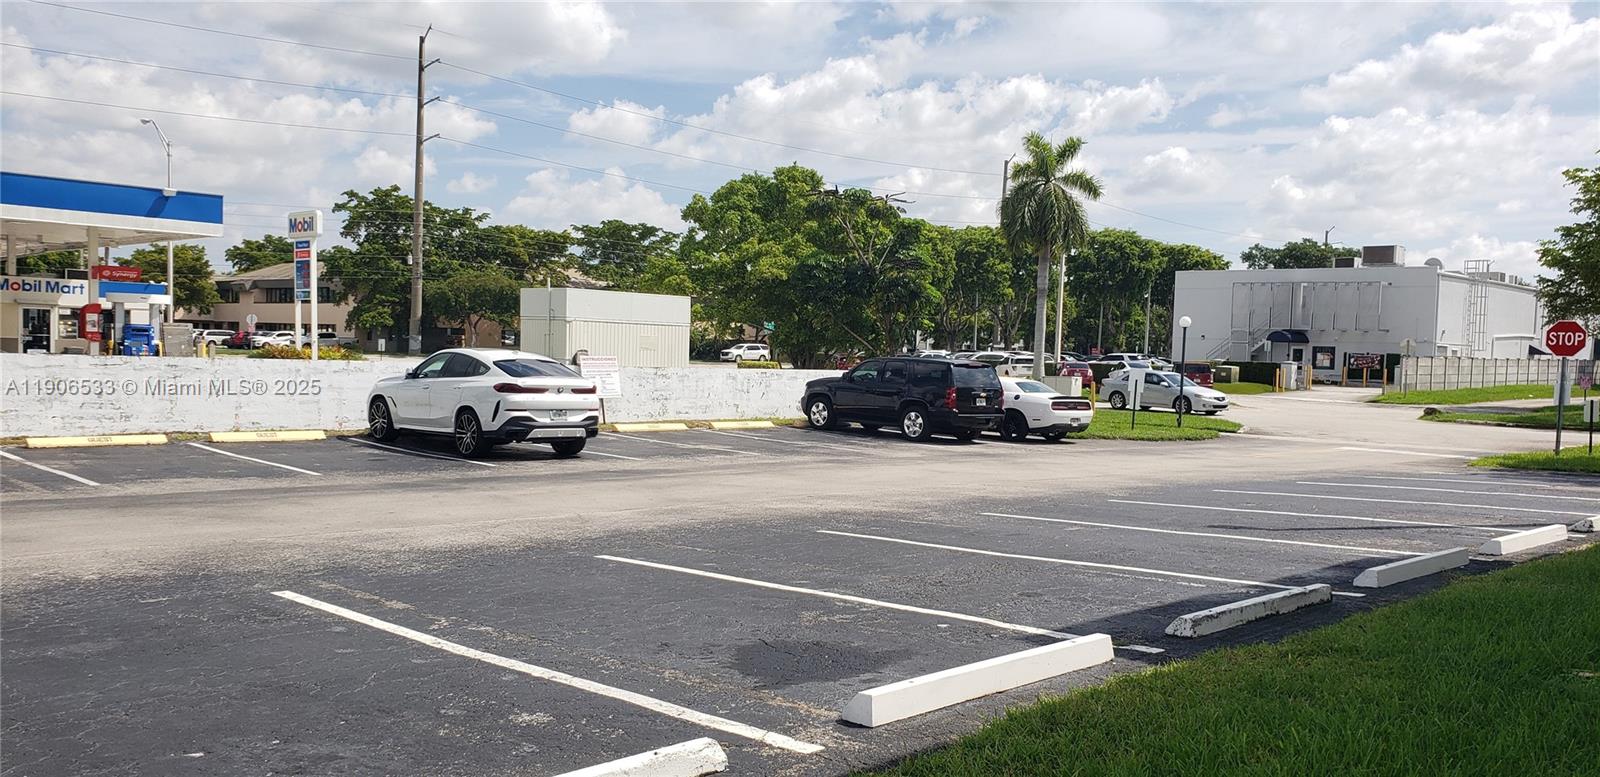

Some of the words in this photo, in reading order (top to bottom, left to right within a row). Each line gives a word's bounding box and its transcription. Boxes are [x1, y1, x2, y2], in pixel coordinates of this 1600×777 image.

[289, 216, 314, 233] Mobil
[112, 270, 138, 279] Synergy
[0, 278, 42, 293] Mobil
[45, 280, 85, 295] Mart
[1547, 331, 1584, 346] STOP
